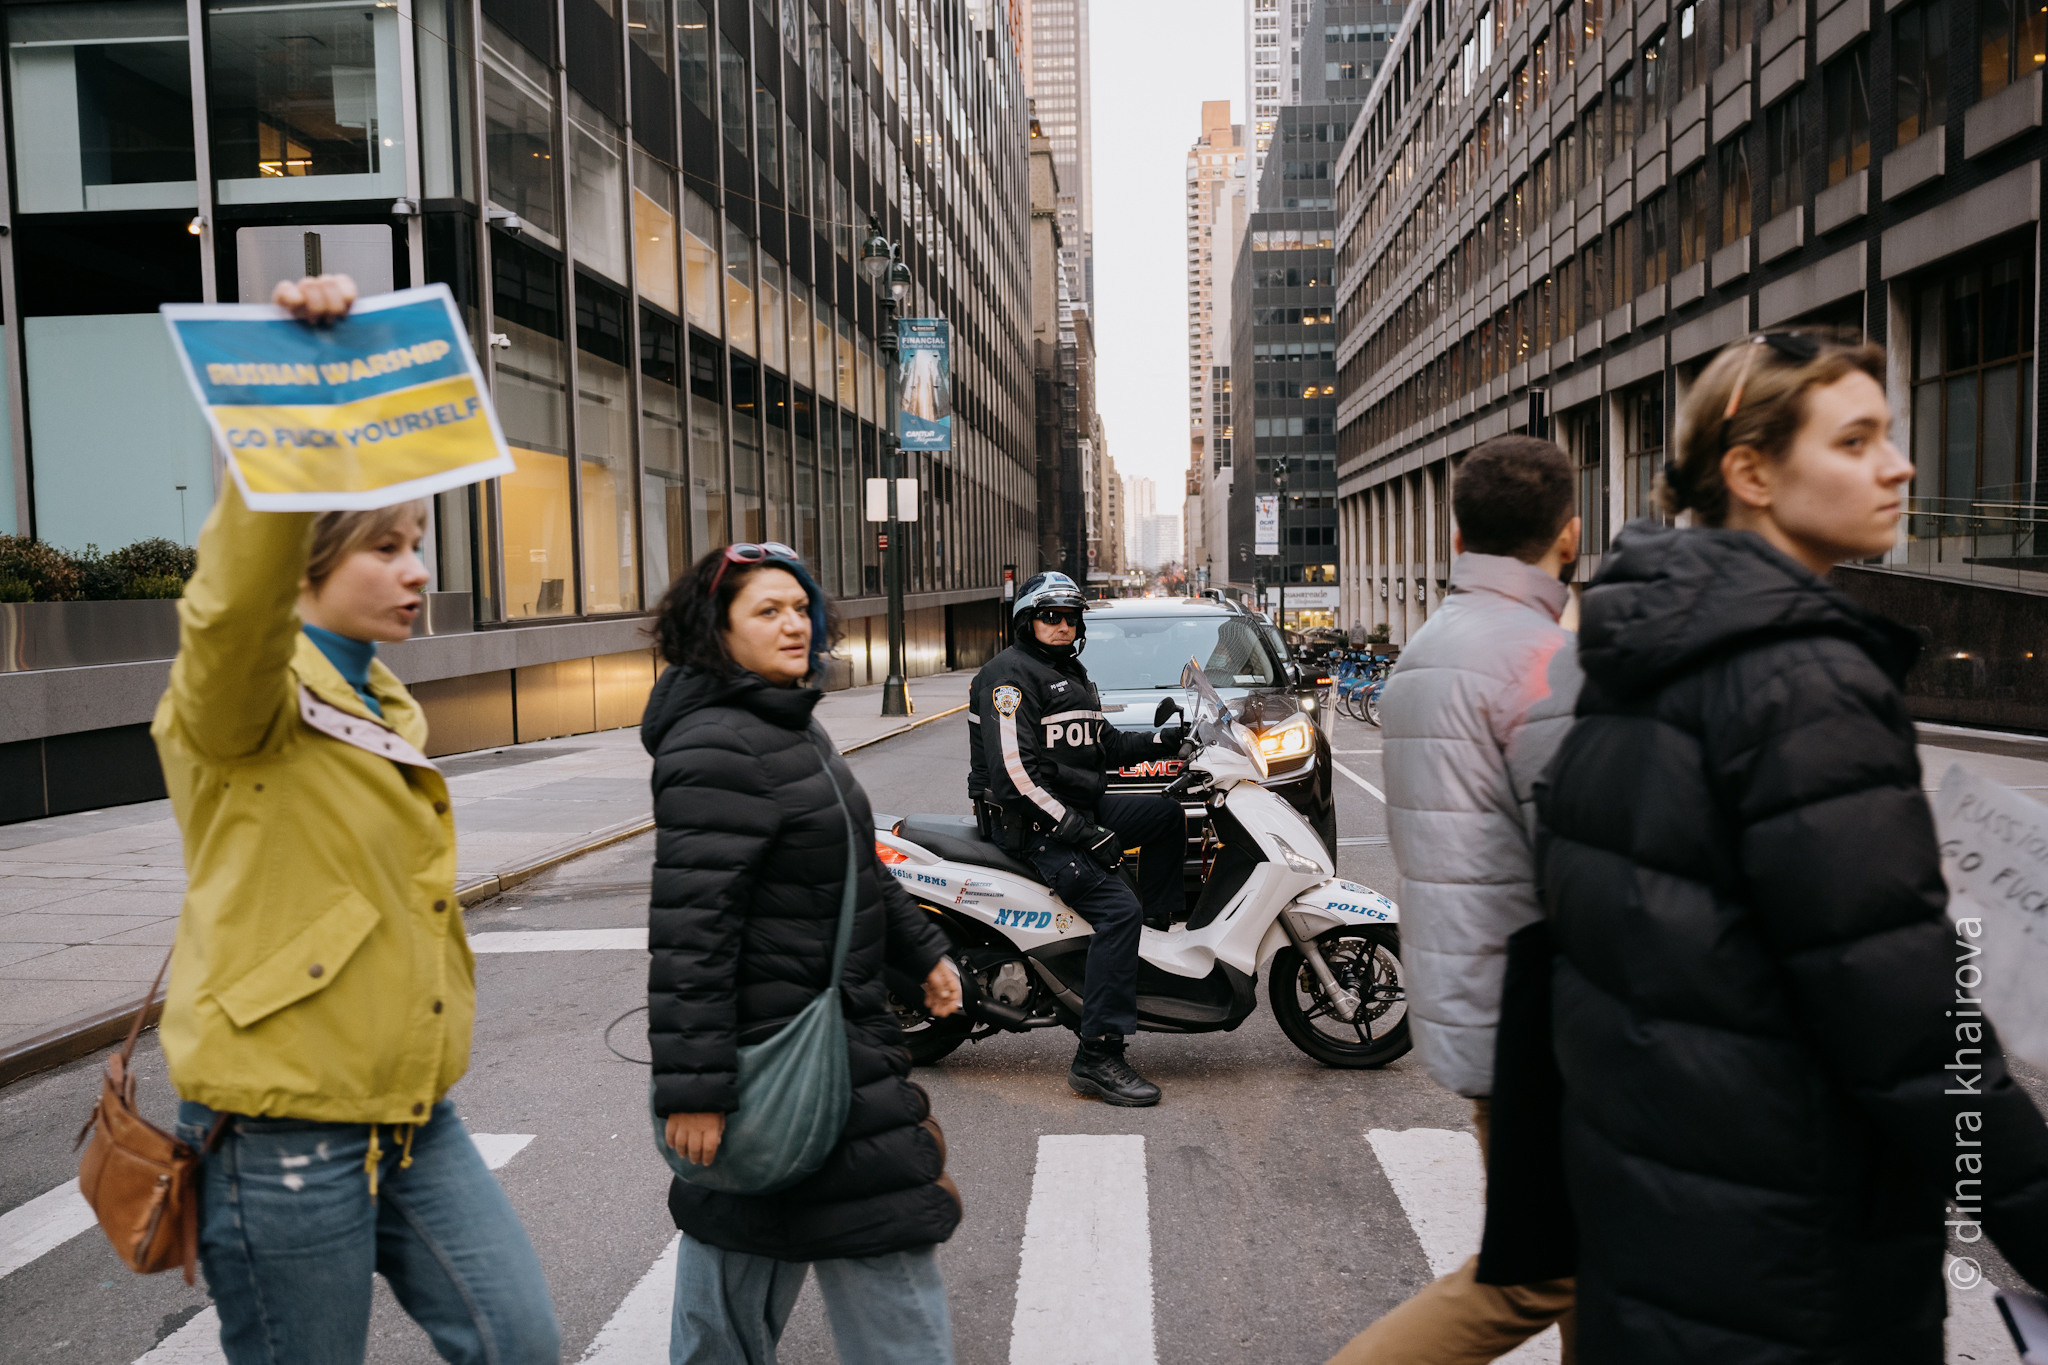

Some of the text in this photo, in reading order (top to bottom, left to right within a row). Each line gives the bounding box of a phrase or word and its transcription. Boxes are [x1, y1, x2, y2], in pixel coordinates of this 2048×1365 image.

[206, 338, 451, 387] RUSSIAN WARSHIP
[226, 396, 481, 450] GO FUCK YOURSELF
[905, 430, 935, 438] CANTOR
[1046, 720, 1104, 749] POL
[1119, 761, 1184, 777] GMC
[917, 873, 947, 887] PBMS
[1990, 867, 2048, 913] FUC
[993, 908, 1052, 929] NYPD
[1325, 902, 1388, 921] POLICE
